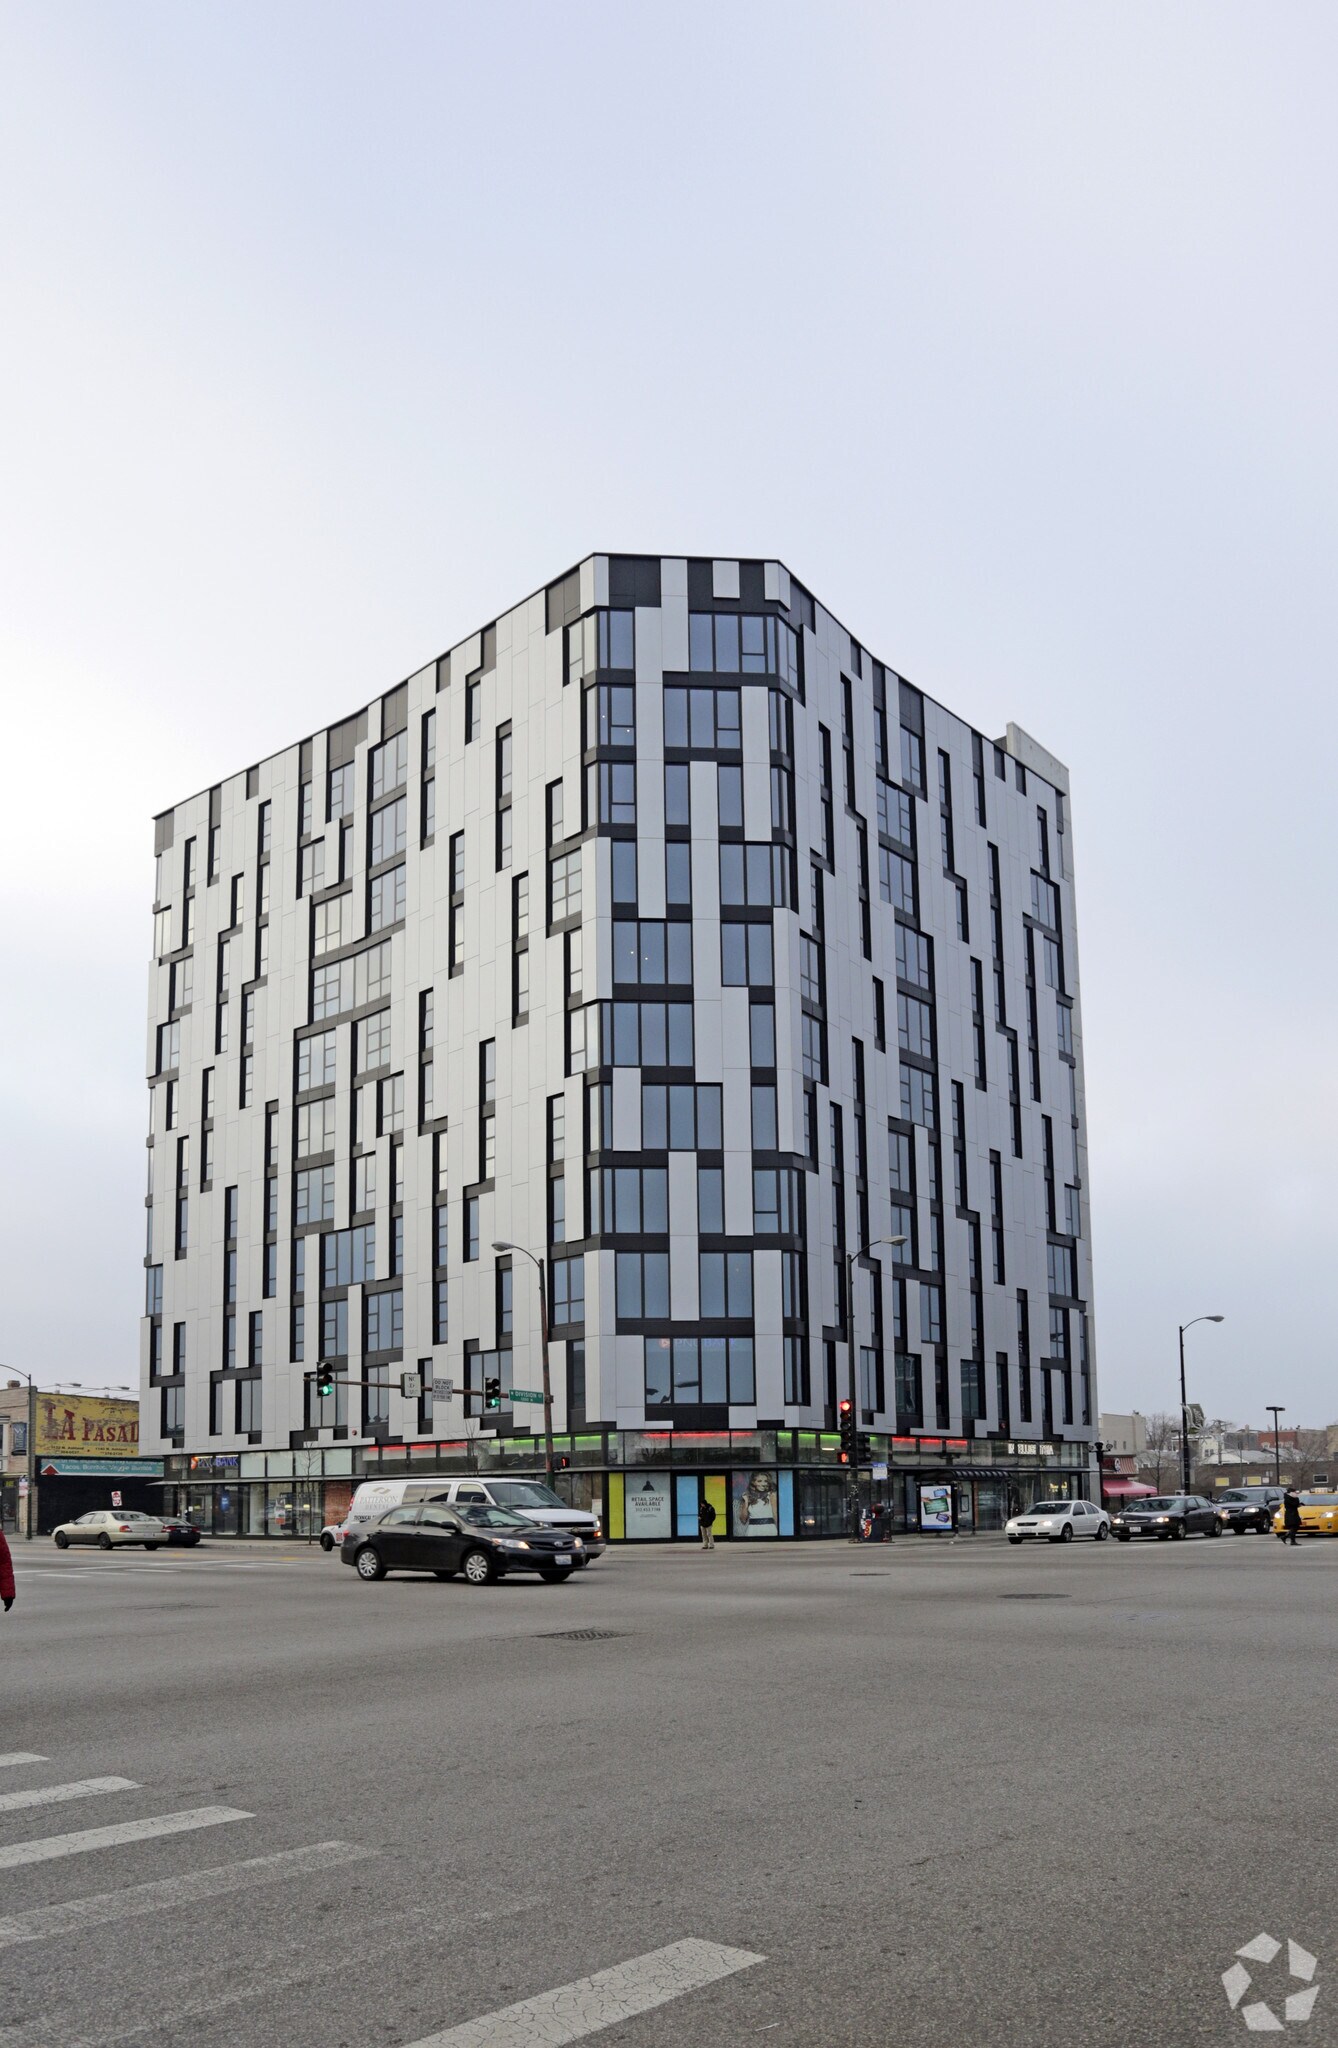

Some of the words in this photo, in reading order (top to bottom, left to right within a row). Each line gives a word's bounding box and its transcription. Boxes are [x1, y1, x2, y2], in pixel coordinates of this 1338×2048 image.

[515, 1391, 537, 1399] DIVISION
[44, 1400, 76, 1440] LA
[215, 1457, 239, 1467] BANK
[360, 1496, 398, 1504] PATTERSON
